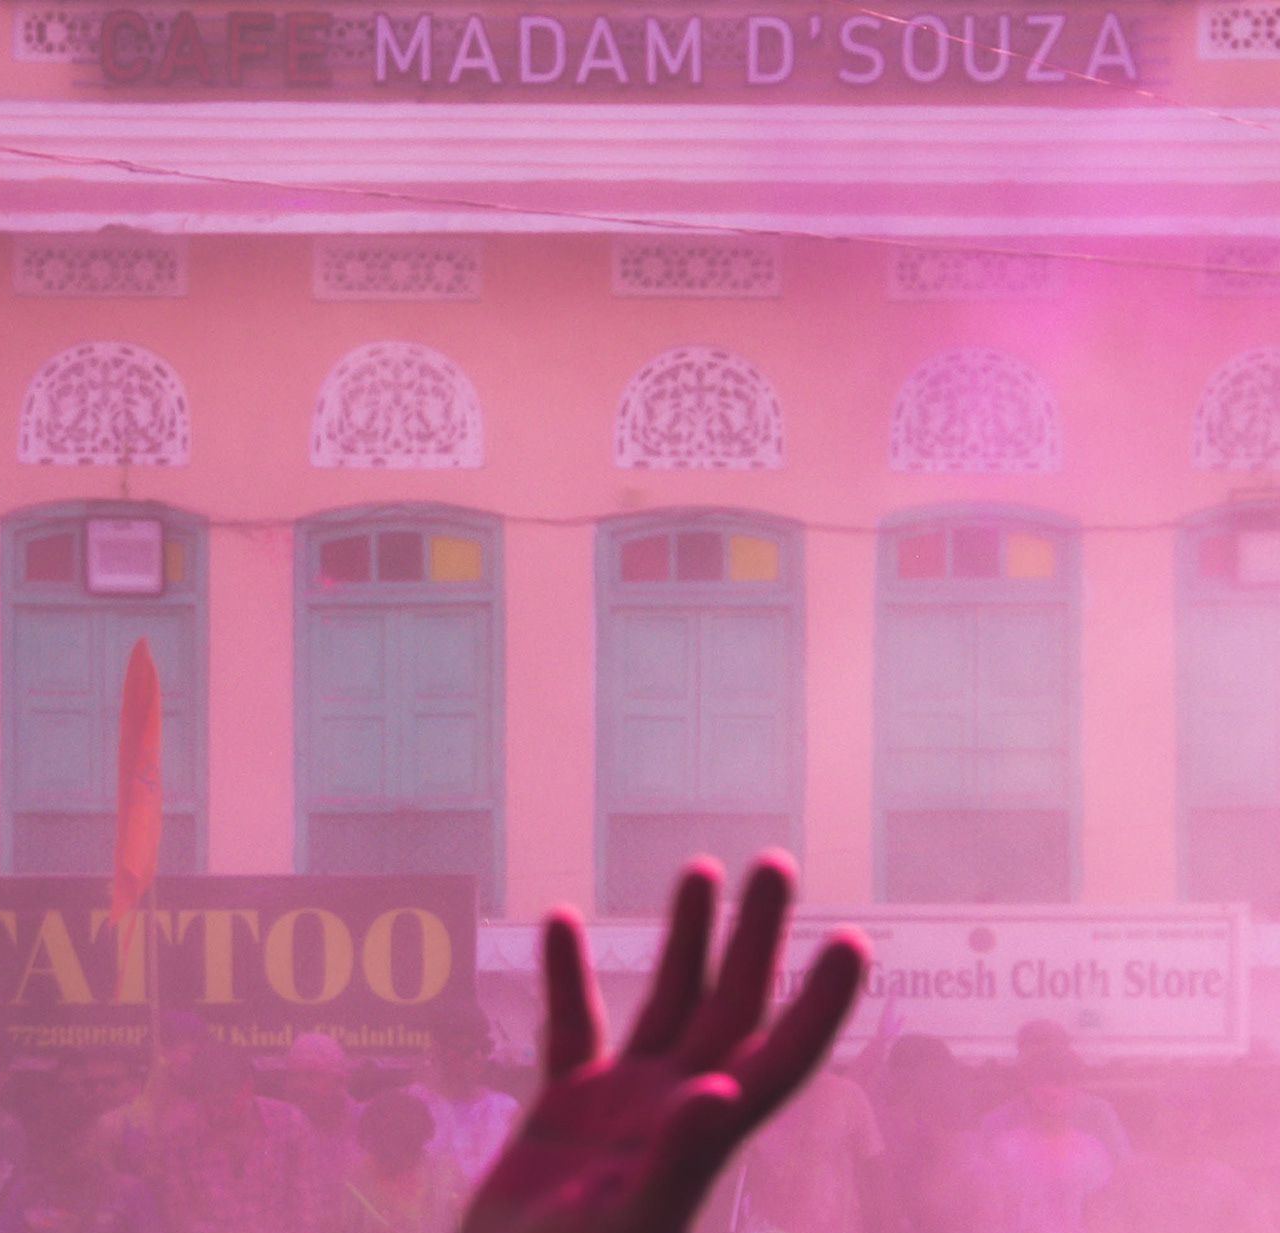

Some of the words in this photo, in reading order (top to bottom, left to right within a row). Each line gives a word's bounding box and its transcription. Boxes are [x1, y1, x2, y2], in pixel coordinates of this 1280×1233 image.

[102, 11, 333, 83] CAFE
[373, 14, 703, 84] MADAM
[745, 12, 1138, 84] D'SOUZA
[864, 958, 997, 999] Ganesh
[1010, 958, 1111, 1000] Cloth
[1123, 959, 1223, 1000] Store
